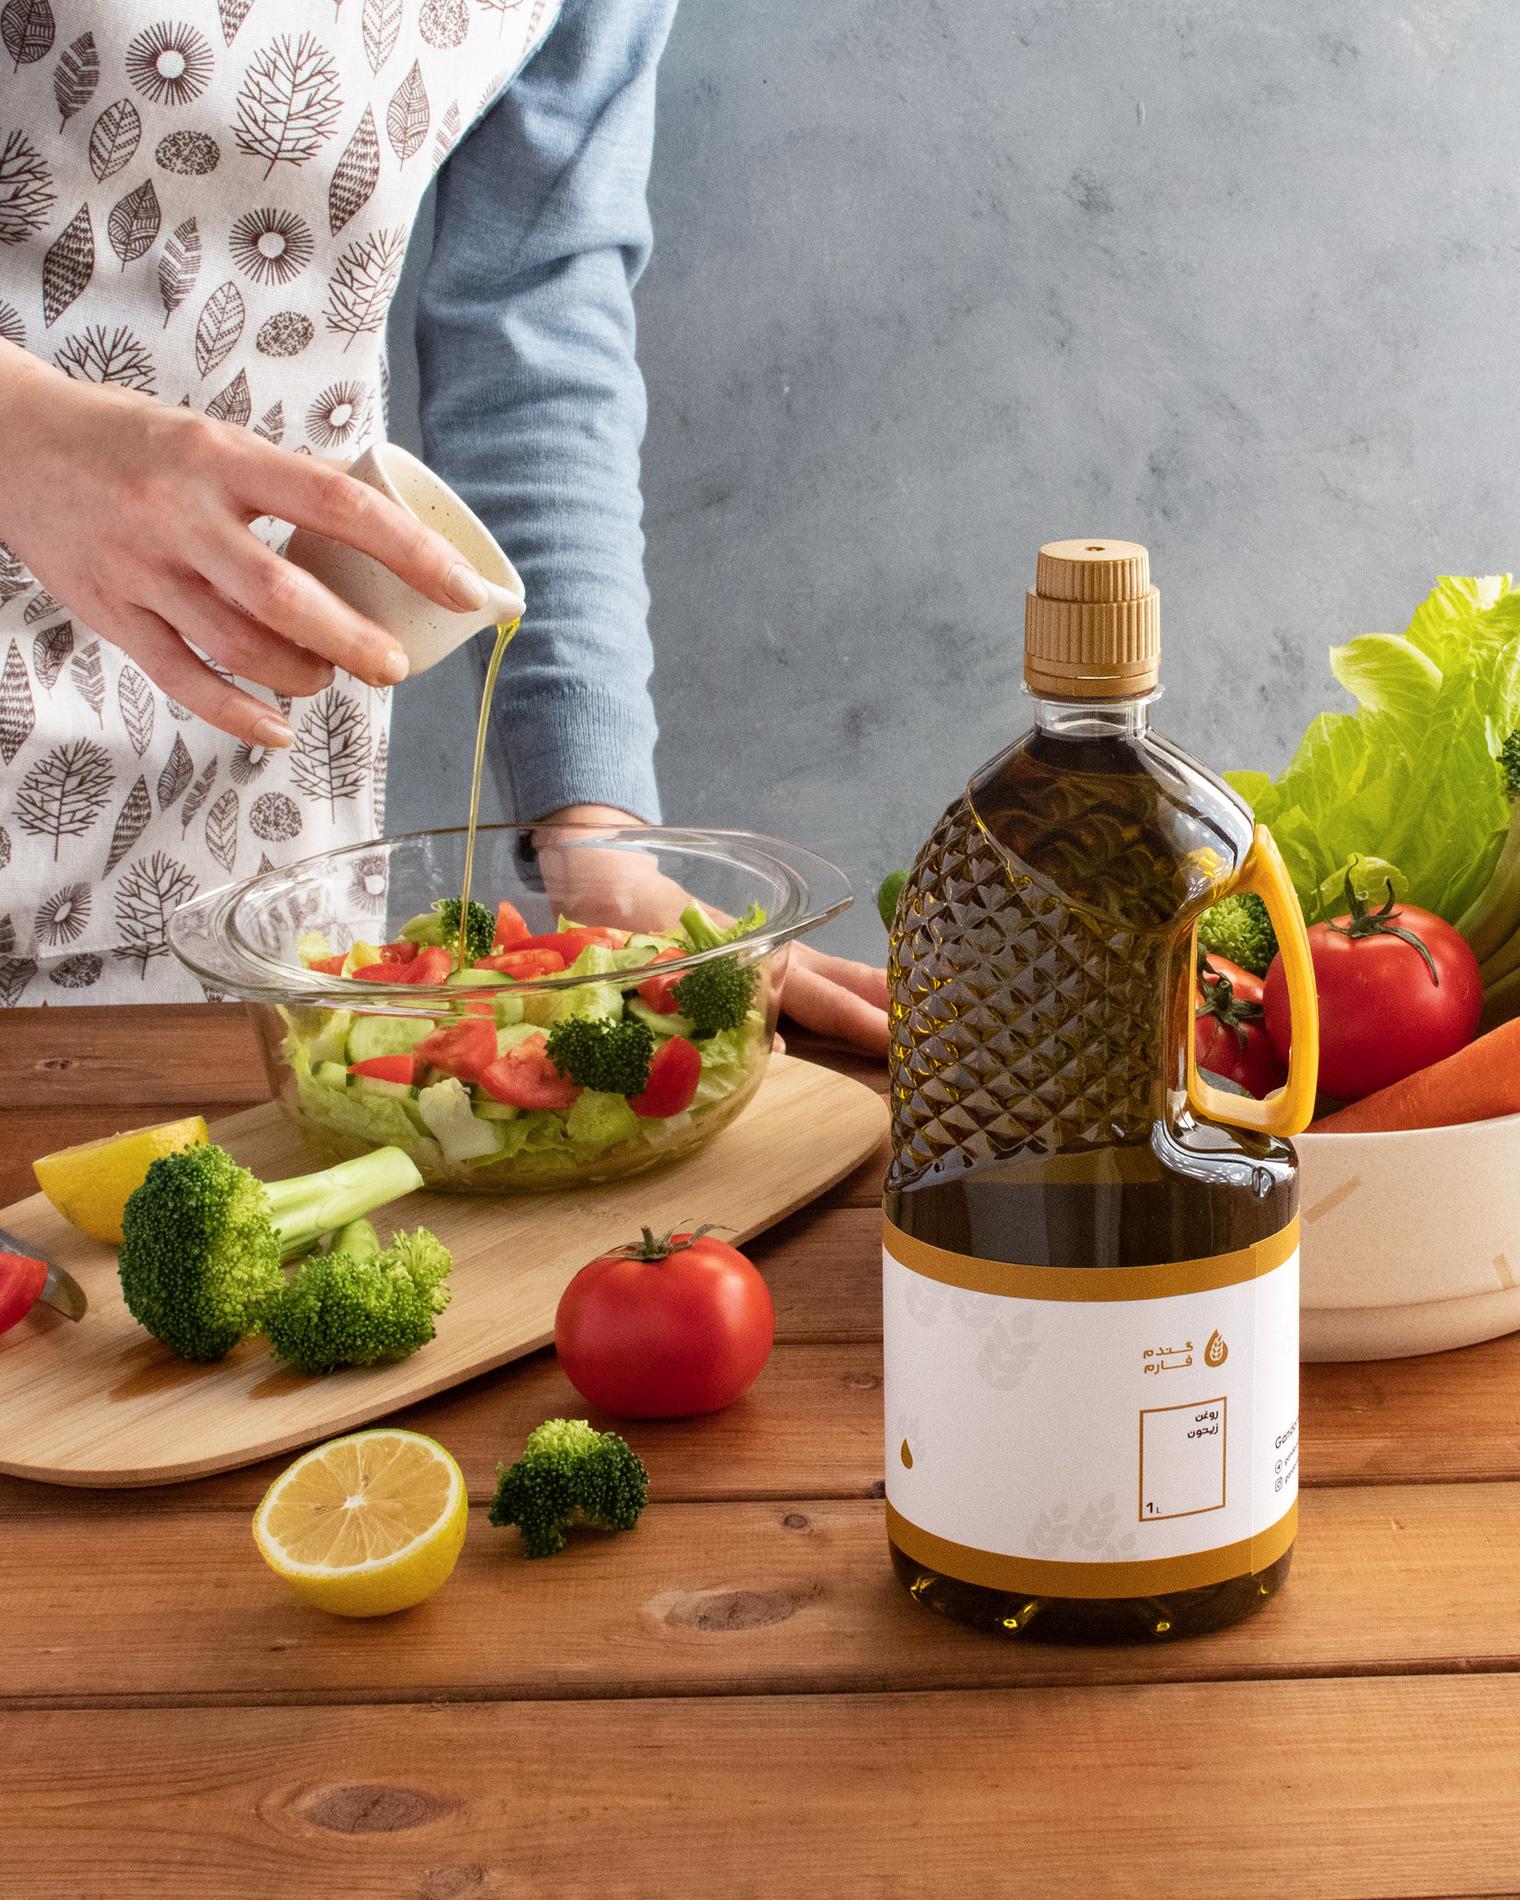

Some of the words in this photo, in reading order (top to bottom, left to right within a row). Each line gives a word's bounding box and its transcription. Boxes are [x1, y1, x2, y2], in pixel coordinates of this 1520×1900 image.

[1143, 1341, 1194, 1359] گندم
[1144, 1355, 1193, 1375] فارم
[1195, 1410, 1219, 1422] روغن
[1187, 1423, 1219, 1439] زیتون
